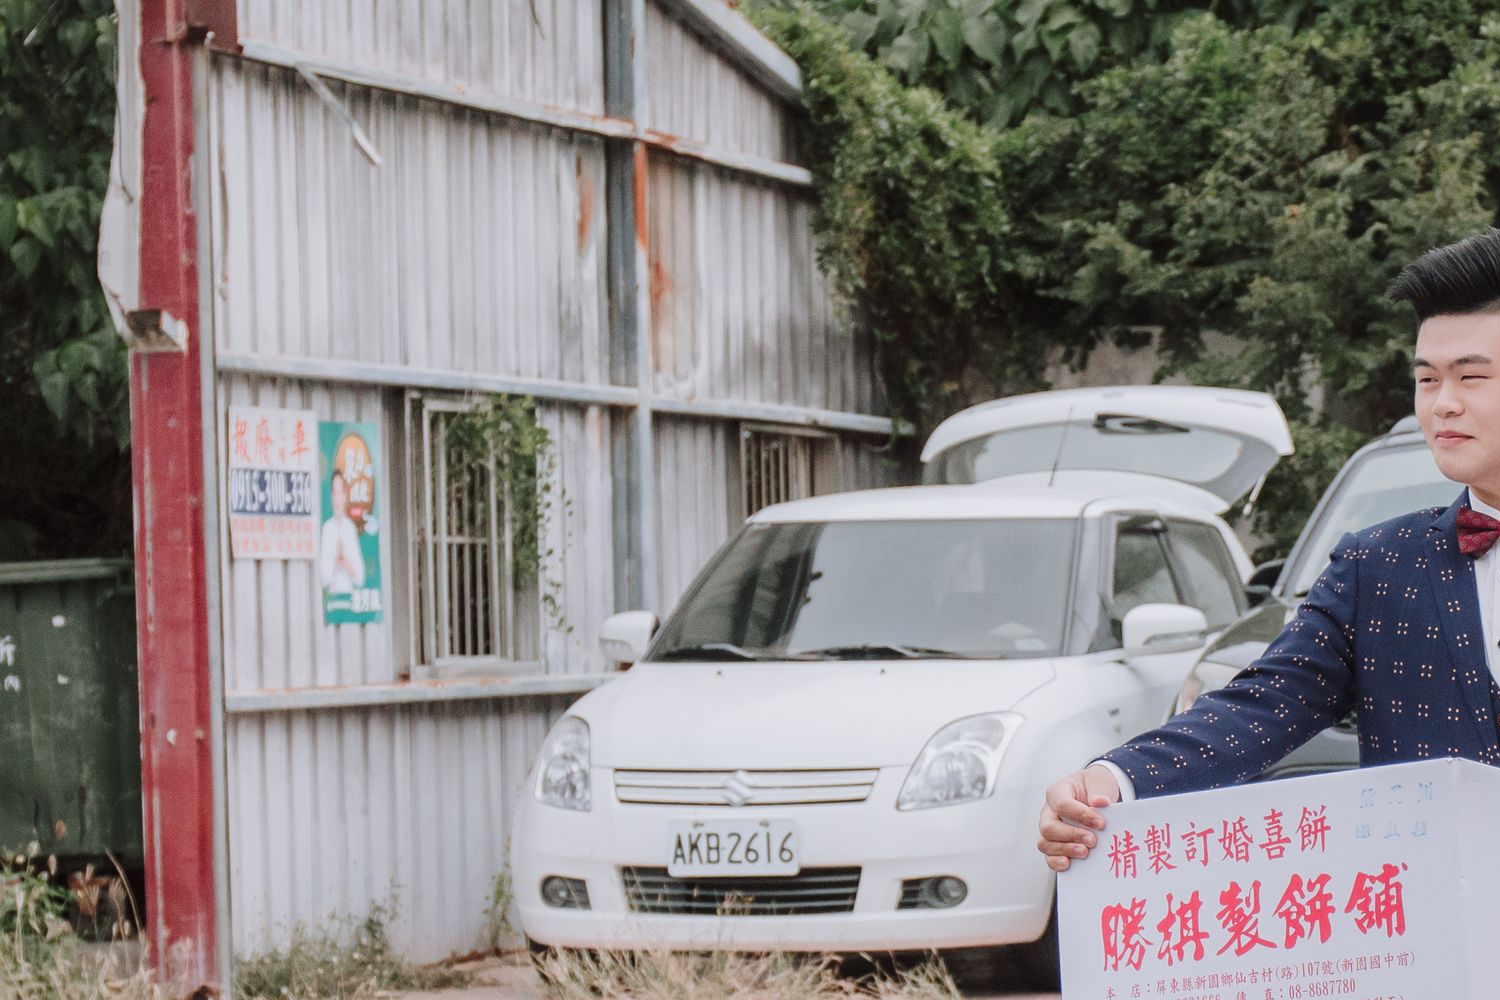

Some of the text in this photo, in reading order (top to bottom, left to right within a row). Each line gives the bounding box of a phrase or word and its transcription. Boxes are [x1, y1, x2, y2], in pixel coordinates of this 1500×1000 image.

[1107, 804, 1332, 880] 精製訂婚喜餅
